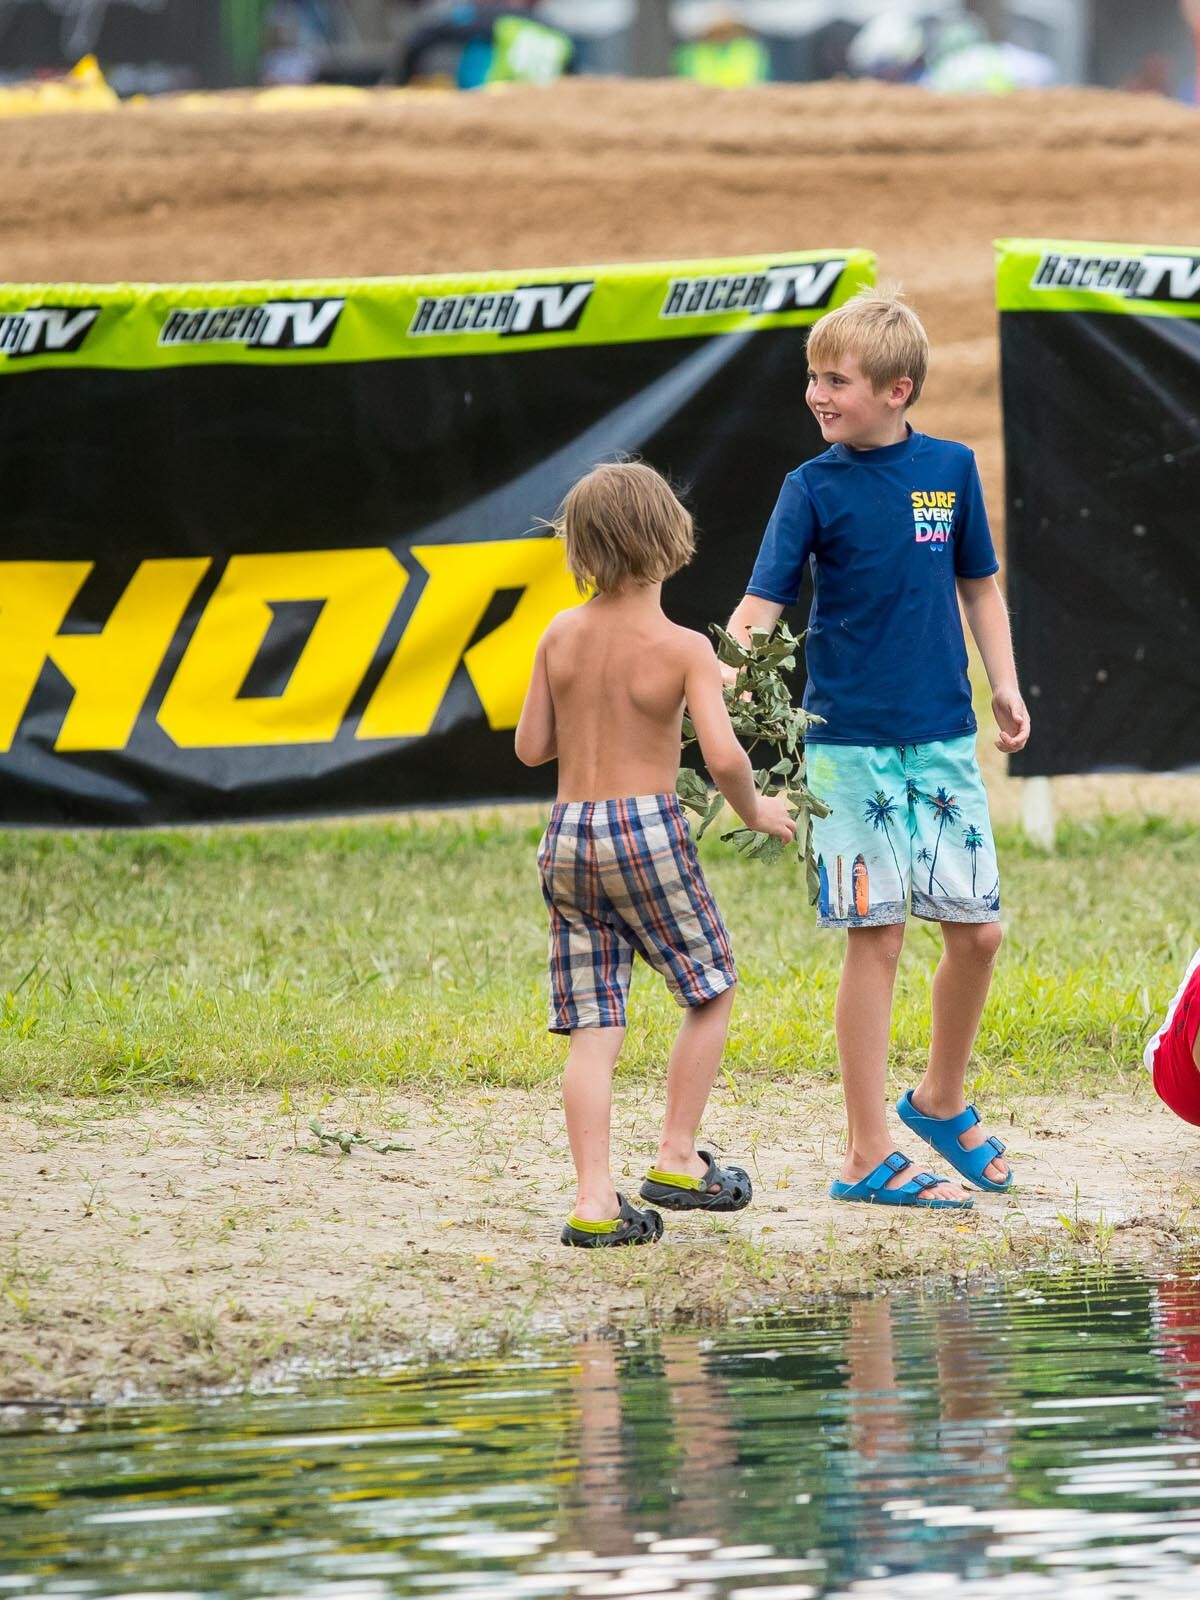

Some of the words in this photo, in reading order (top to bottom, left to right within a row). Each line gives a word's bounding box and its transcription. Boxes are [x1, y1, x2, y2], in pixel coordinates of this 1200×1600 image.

[911, 491, 956, 508] SURF
[913, 507, 954, 522] EVERY
[915, 522, 952, 542] DAY
